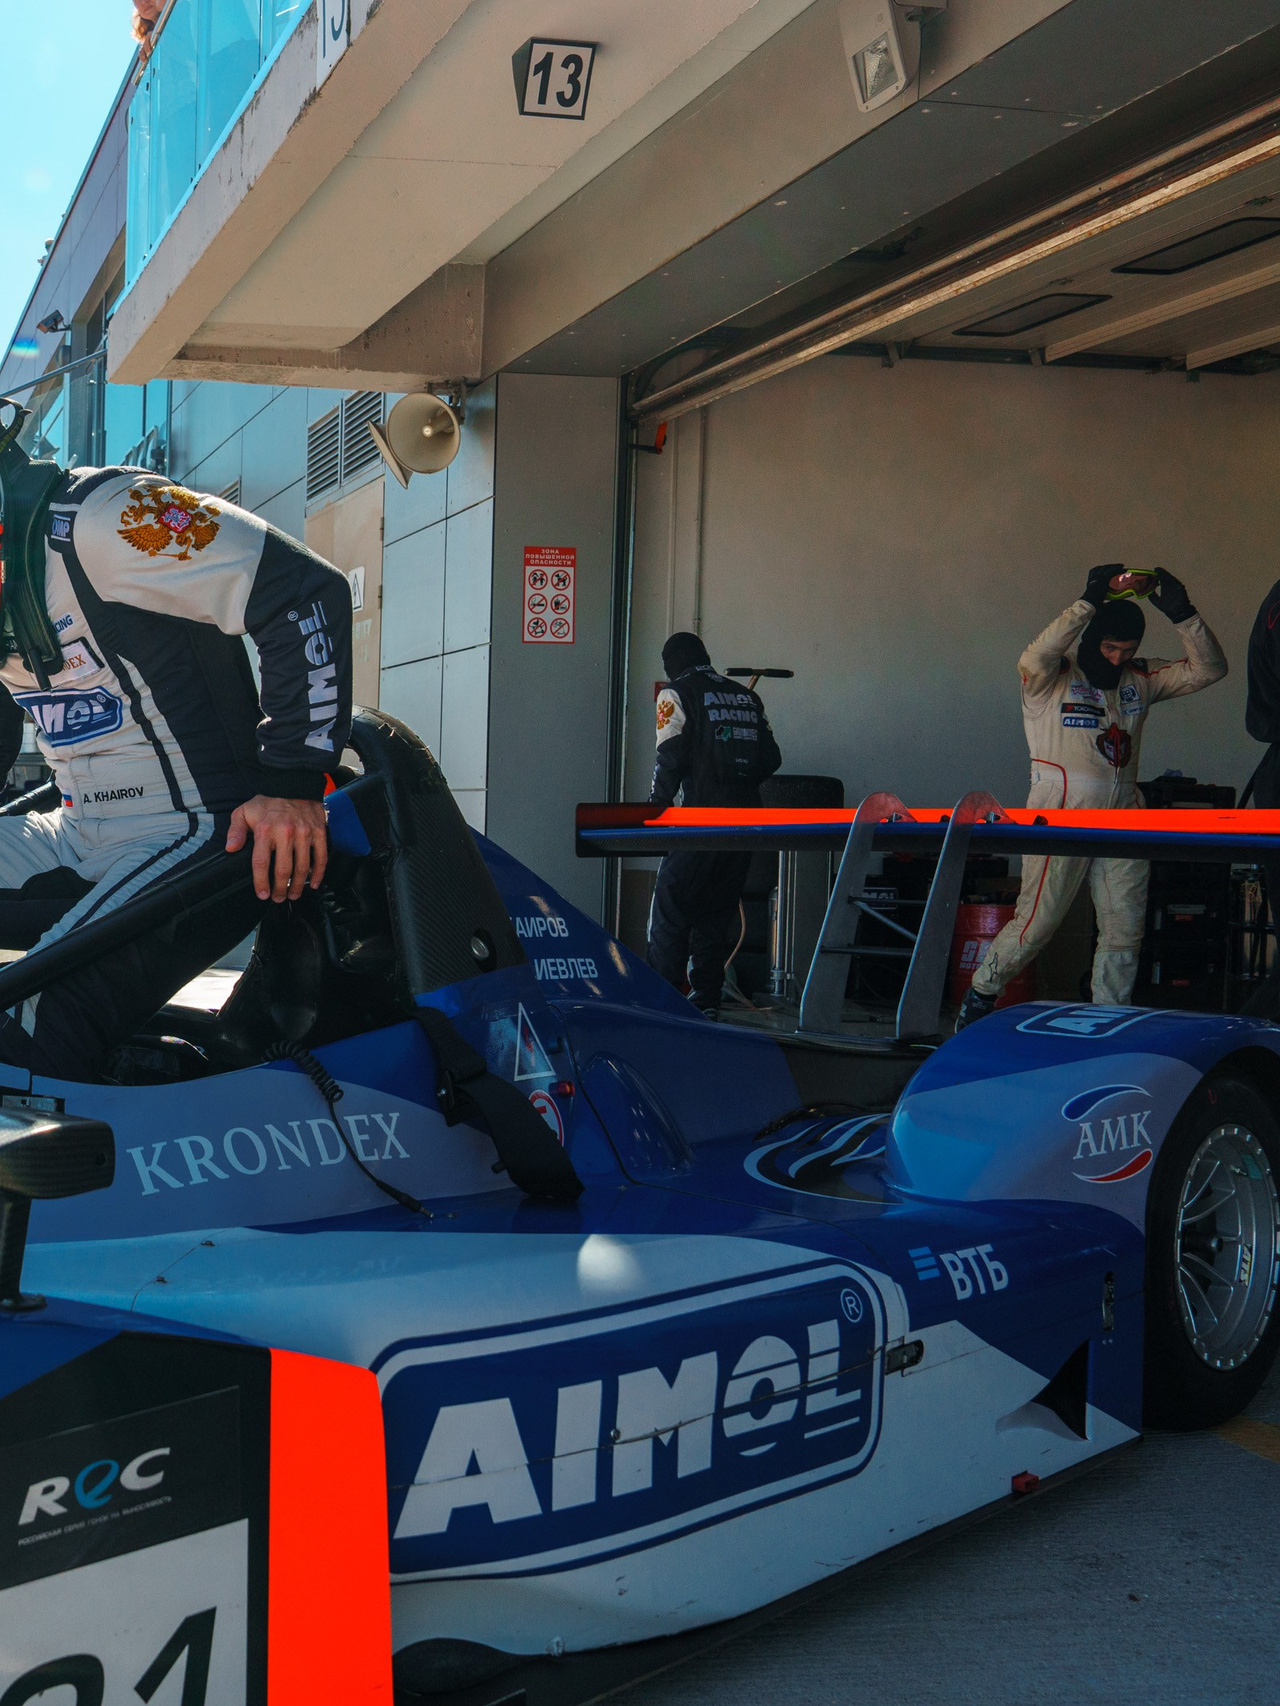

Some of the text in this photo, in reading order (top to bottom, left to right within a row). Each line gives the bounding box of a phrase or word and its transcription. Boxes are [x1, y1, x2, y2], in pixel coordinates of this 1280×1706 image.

[533, 51, 584, 108] 13
[51, 518, 70, 538] OMP
[53, 614, 74, 634] CING
[297, 600, 339, 753] AIMOL
[703, 691, 757, 708] AIMOL
[708, 708, 758, 724] RACING
[1062, 718, 1098, 727] AIMOL
[94, 786, 144, 803] KHAIROV
[511, 916, 569, 938] АИРОВ
[533, 957, 599, 981] ИЕВЛЕВ
[125, 1111, 411, 1197] KRONDEX
[938, 1243, 1009, 1301] ВТБ
[393, 1319, 863, 1541] AIMOL
[17, 1528, 63, 1547] РОССИЙСКАЯ
[63, 1520, 87, 1534] СЕРИЯ
[110, 1511, 121, 1520] НА
[121, 1494, 173, 1517] ВЫНОСЛИВОСТЬ
